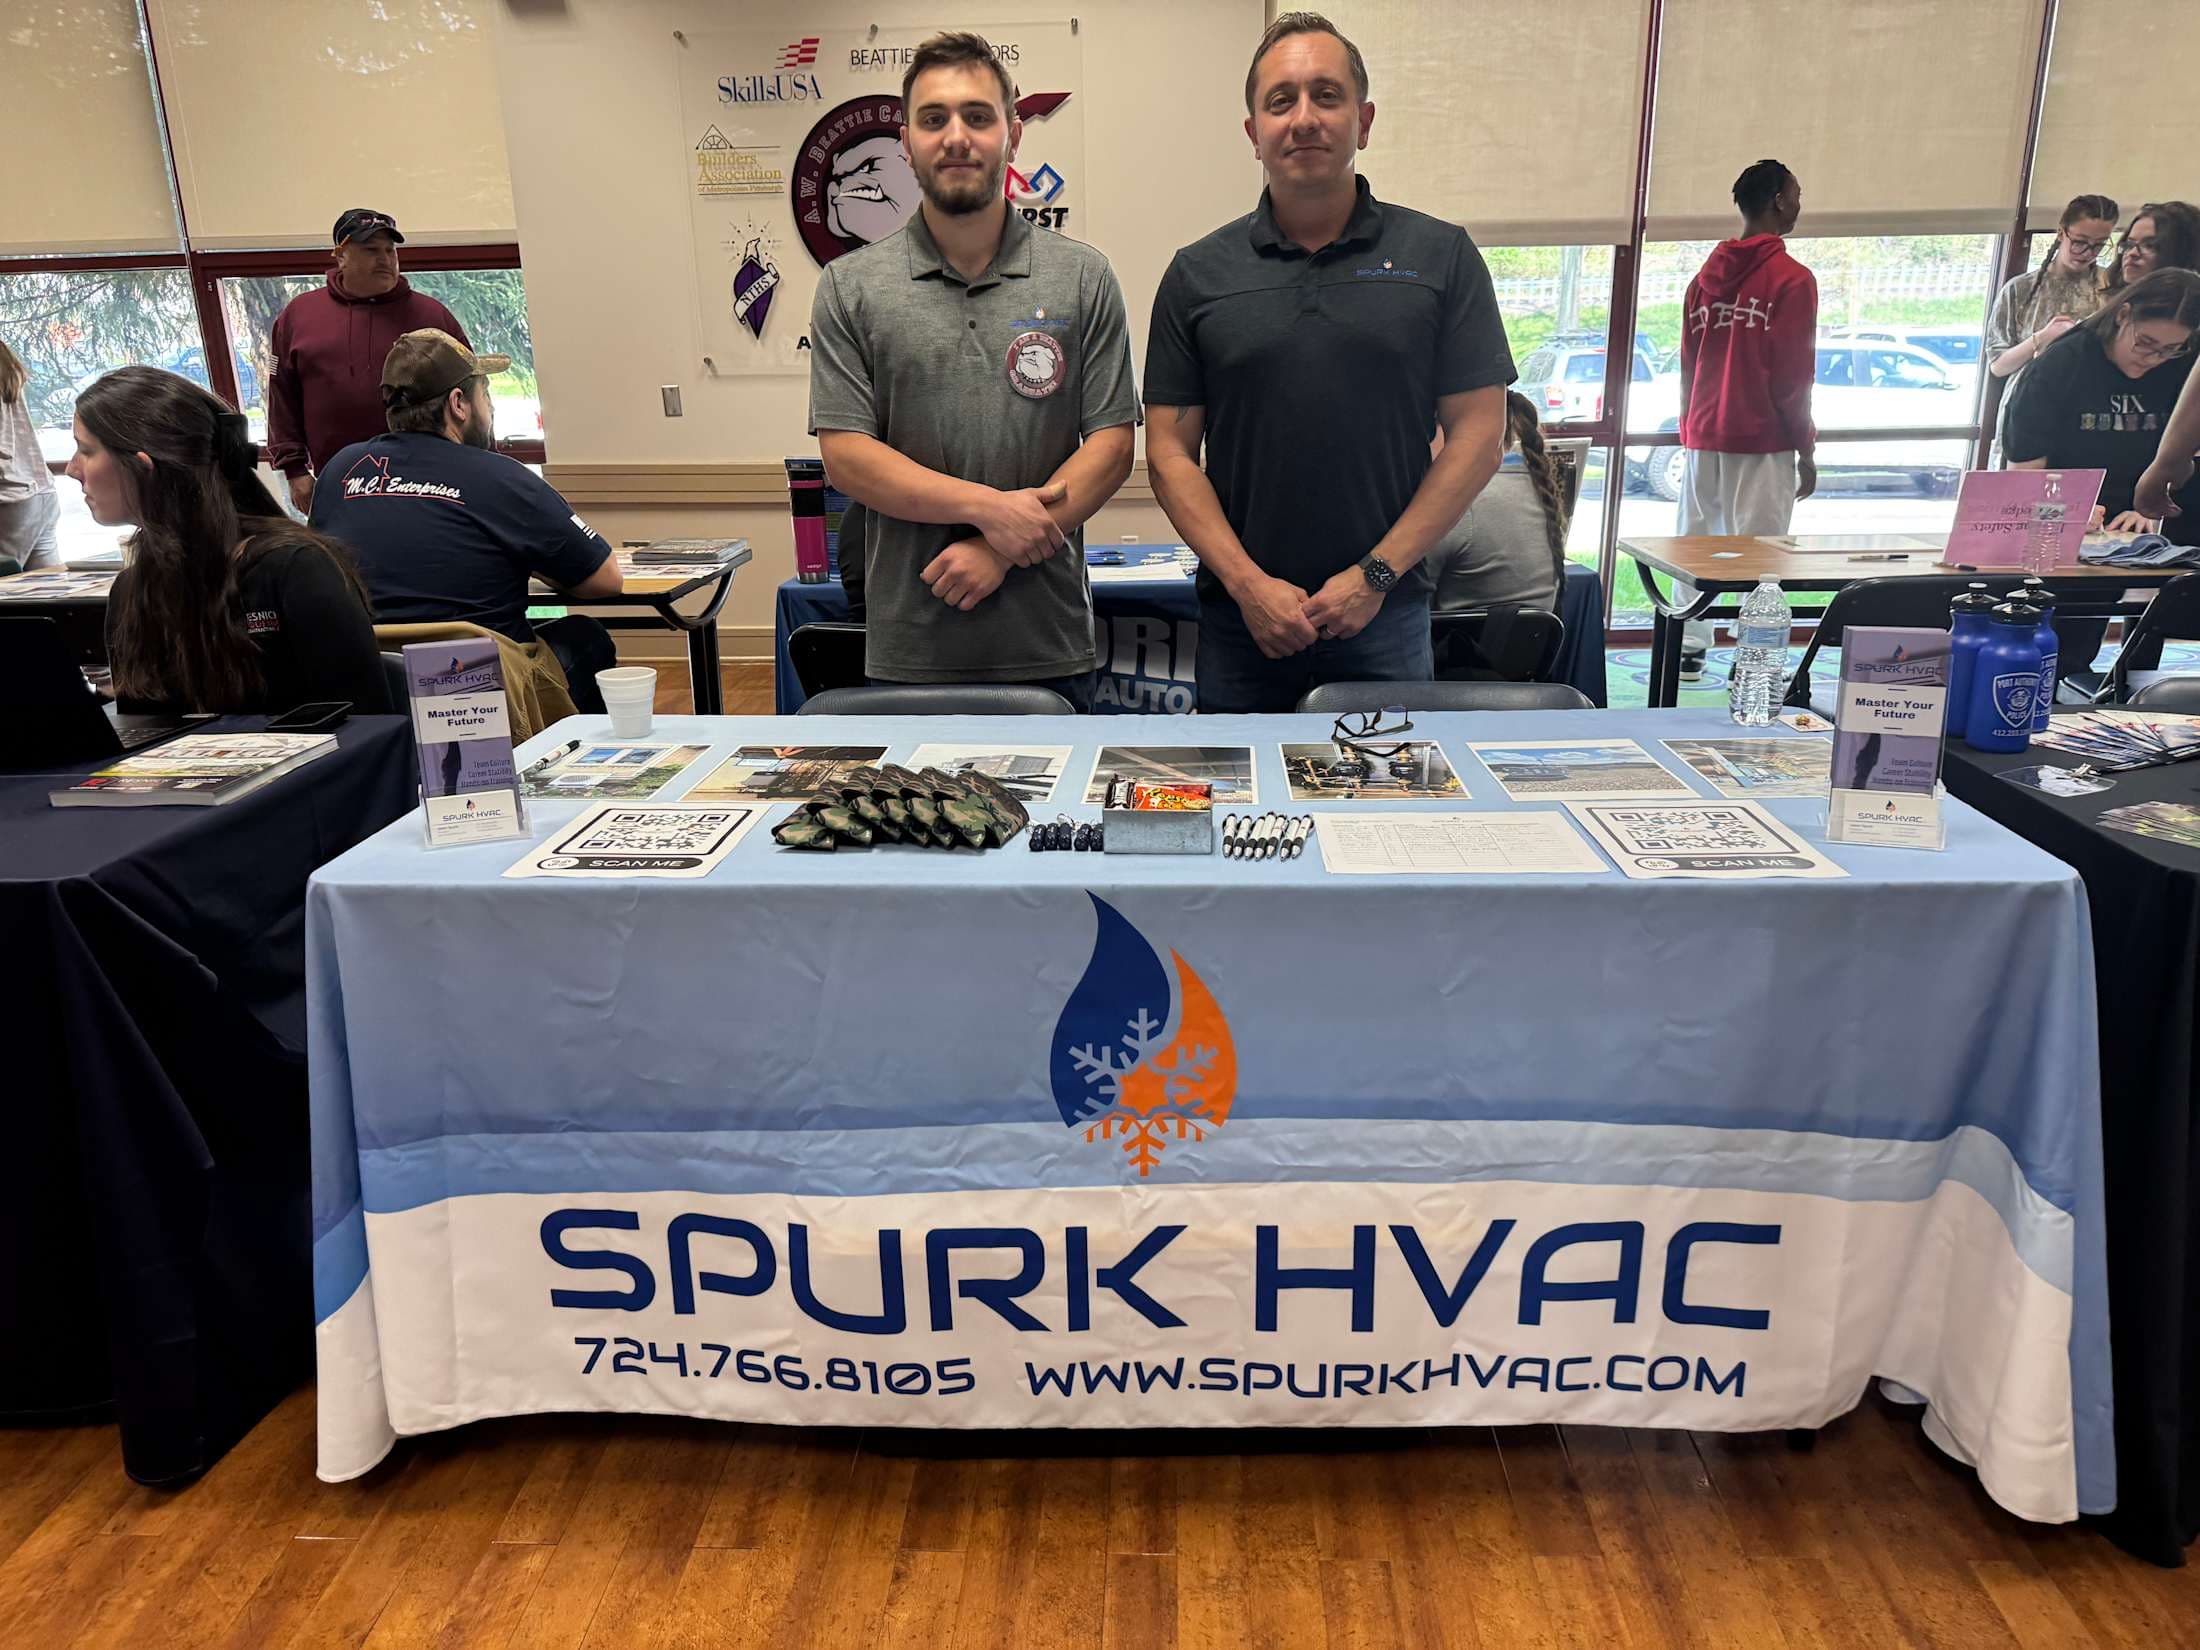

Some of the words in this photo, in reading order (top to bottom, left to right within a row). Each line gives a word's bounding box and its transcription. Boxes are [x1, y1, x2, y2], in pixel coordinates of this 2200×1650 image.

[851, 48, 912, 66] BEATTIE
[717, 73, 824, 104] SkillsUSA
[697, 152, 758, 168] Builders
[698, 166, 783, 184] Association
[740, 277, 770, 306] NTHS
[2110, 394, 2145, 414] SIX
[346, 475, 380, 495] M.C.
[386, 476, 461, 499] Enterprises
[1854, 663, 1902, 674] SPURK
[1905, 666, 1945, 676] HVAC
[418, 674, 463, 687] SPURK
[465, 672, 498, 684] HVAC
[1095, 676, 1193, 714] AUTO
[428, 708, 468, 719] Master
[472, 706, 499, 716] Your
[1855, 698, 1899, 708] Master
[1903, 700, 1934, 711] Your
[447, 717, 485, 727] Future
[1874, 709, 1916, 720] Future
[443, 813, 474, 823] SPURK
[476, 810, 502, 819] HVAC
[1857, 812, 1893, 822] SPURK
[1895, 815, 1923, 824] HVAC
[1691, 859, 1751, 868] SCAN
[1758, 858, 1797, 867] ME
[540, 1208, 1188, 1335] SPURK
[1254, 1217, 1782, 1334] HVAC
[574, 1336, 976, 1396] 724.766.8105
[1024, 1352, 1748, 1399] WWW.SPURKHVAC.COM
